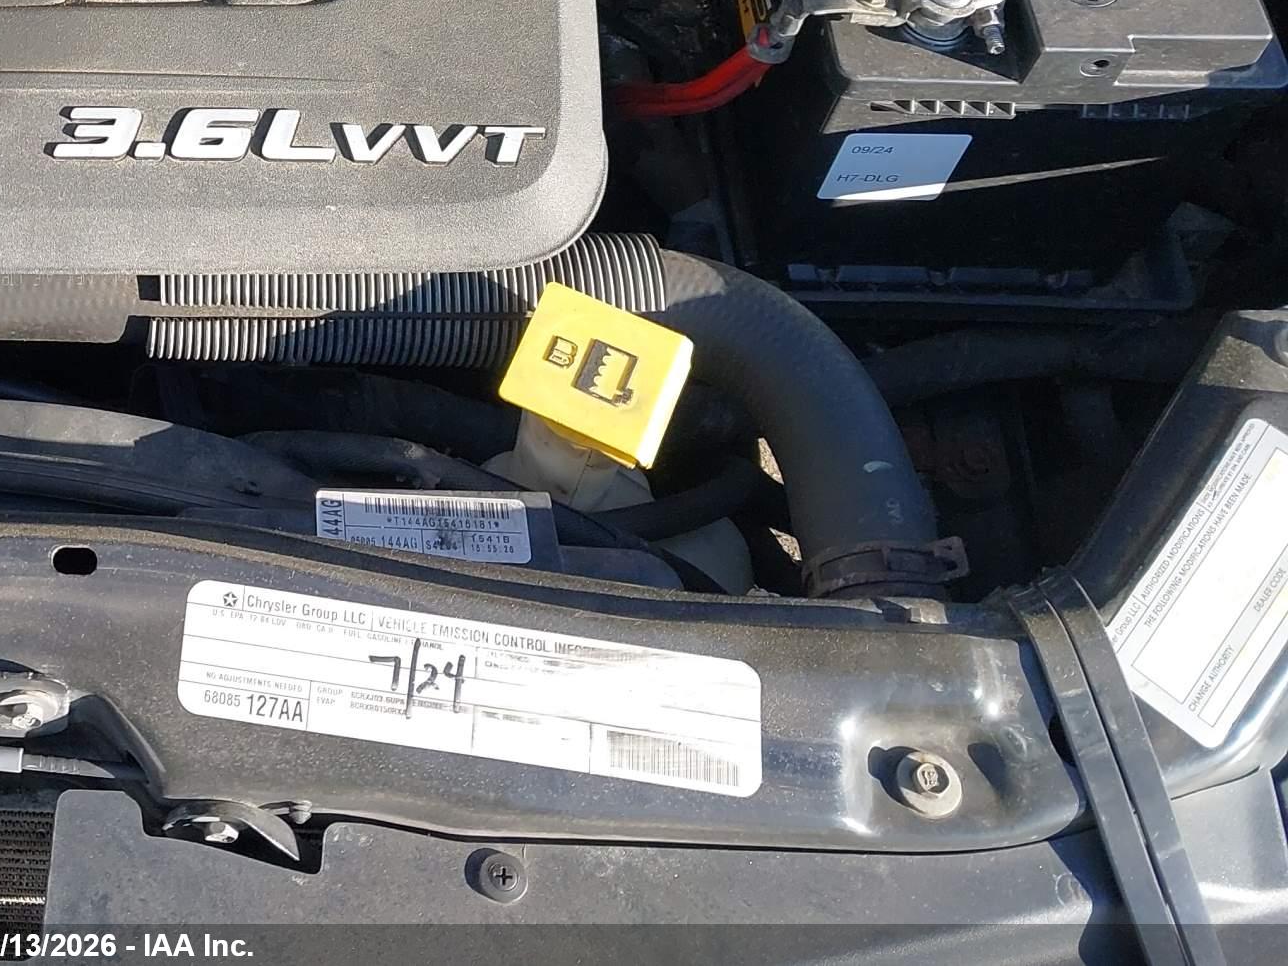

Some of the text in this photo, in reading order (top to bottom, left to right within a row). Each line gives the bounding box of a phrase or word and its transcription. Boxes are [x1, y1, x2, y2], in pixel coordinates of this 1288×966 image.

[45, 106, 546, 168] 3.6L VVT
[851, 145, 895, 155] 09/24
[836, 173, 899, 183] H7-DLG
[321, 499, 342, 536] 44AG
[381, 535, 417, 549] 144AG
[1139, 505, 1206, 602] AUTHORIZED MODIFICATIONS
[1143, 612, 1157, 630] THE
[1151, 573, 1183, 618] FOLLOWING
[1177, 522, 1217, 579] MODIFICATIONS
[1212, 506, 1228, 528] HAVE
[1223, 490, 1239, 510] BEEN
[1252, 565, 1286, 614] DEALER CODE
[246, 594, 366, 625] Chrysler Group LLC
[378, 616, 551, 653] VEHICLE EMISSION CONTROL
[218, 673, 272, 689] ADJUSTMENTS
[368, 637, 466, 720] 7/24
[1187, 641, 1235, 715] CHANGE AUTHORITY
[203, 689, 304, 723] 68085 127AA
